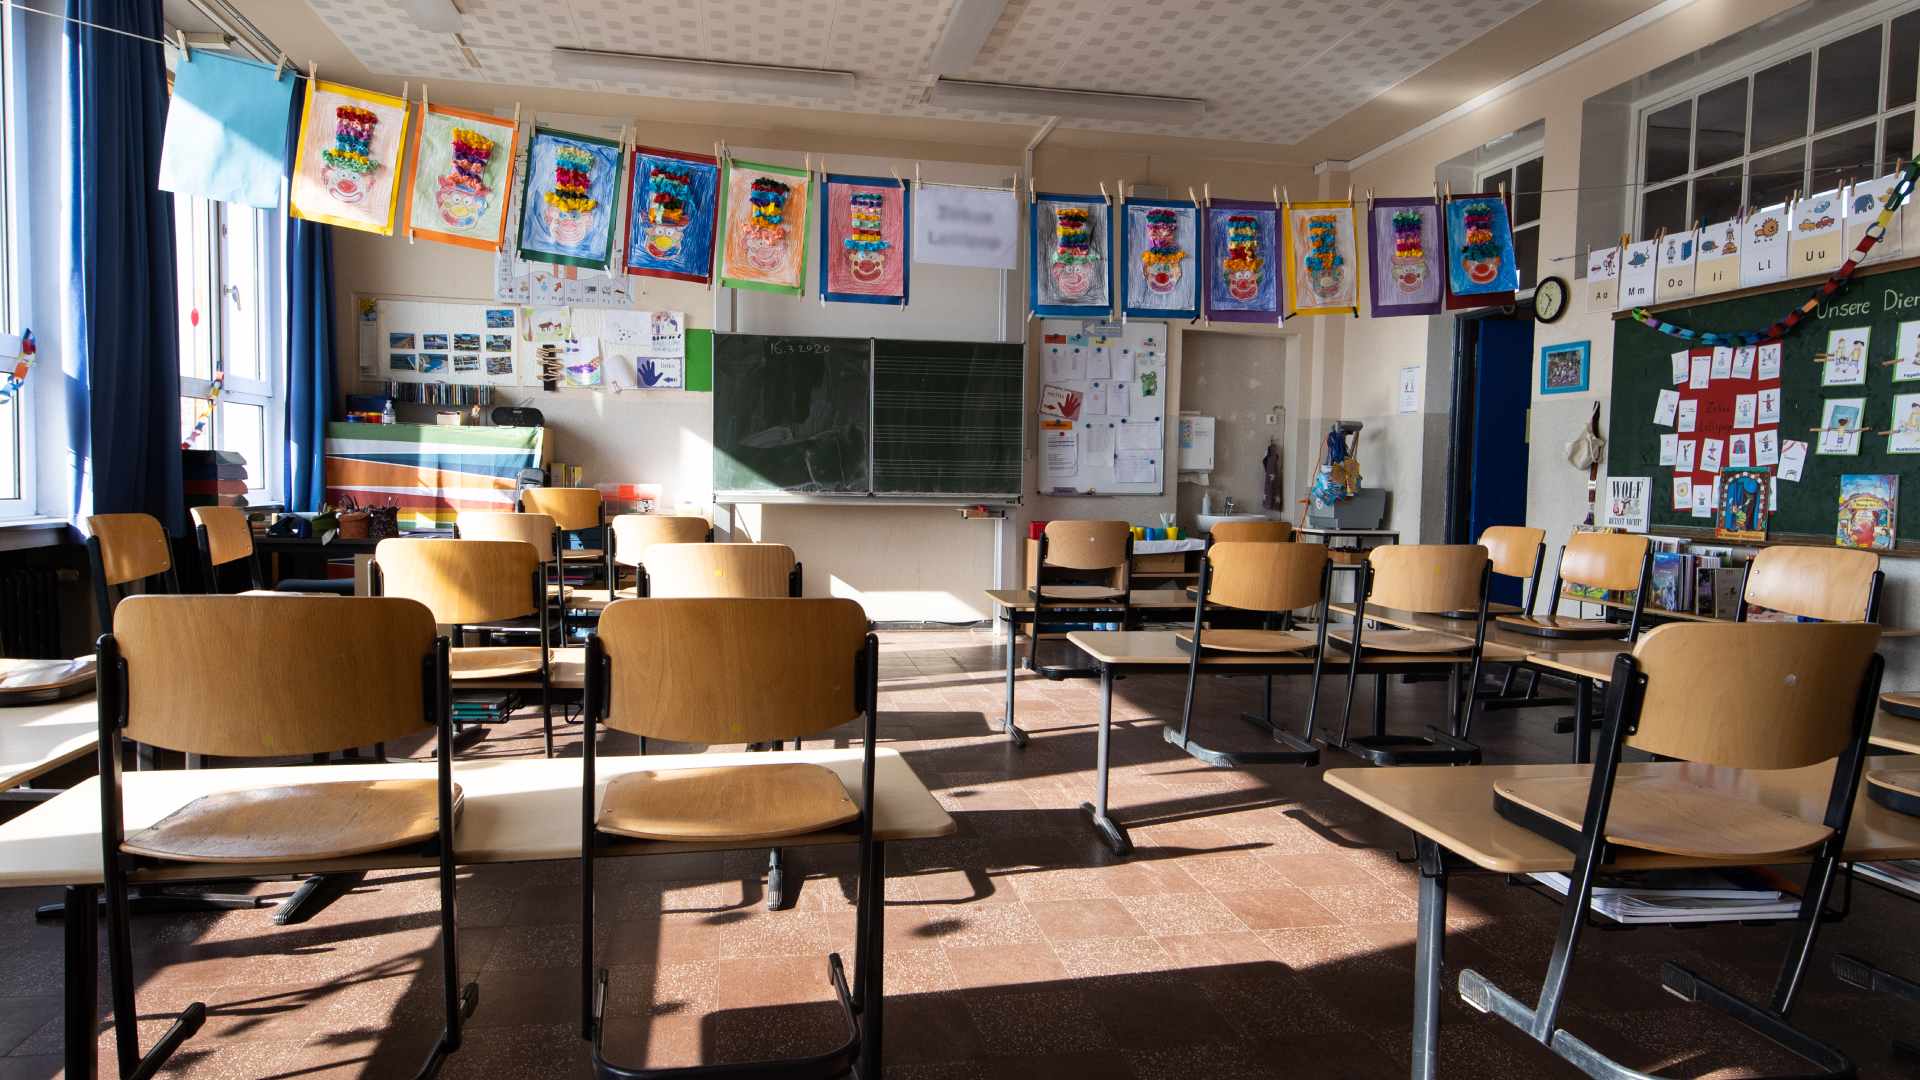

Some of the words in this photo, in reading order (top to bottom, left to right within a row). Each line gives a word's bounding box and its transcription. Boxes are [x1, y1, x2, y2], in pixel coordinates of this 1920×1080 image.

[1805, 251, 1814, 262] U
[1758, 261, 1764, 271] L
[1668, 278, 1675, 288] O
[1628, 287, 1635, 296] M
[1637, 287, 1645, 295] m
[1817, 300, 1871, 320] Unsere
[1612, 481, 1644, 499] WOLF
